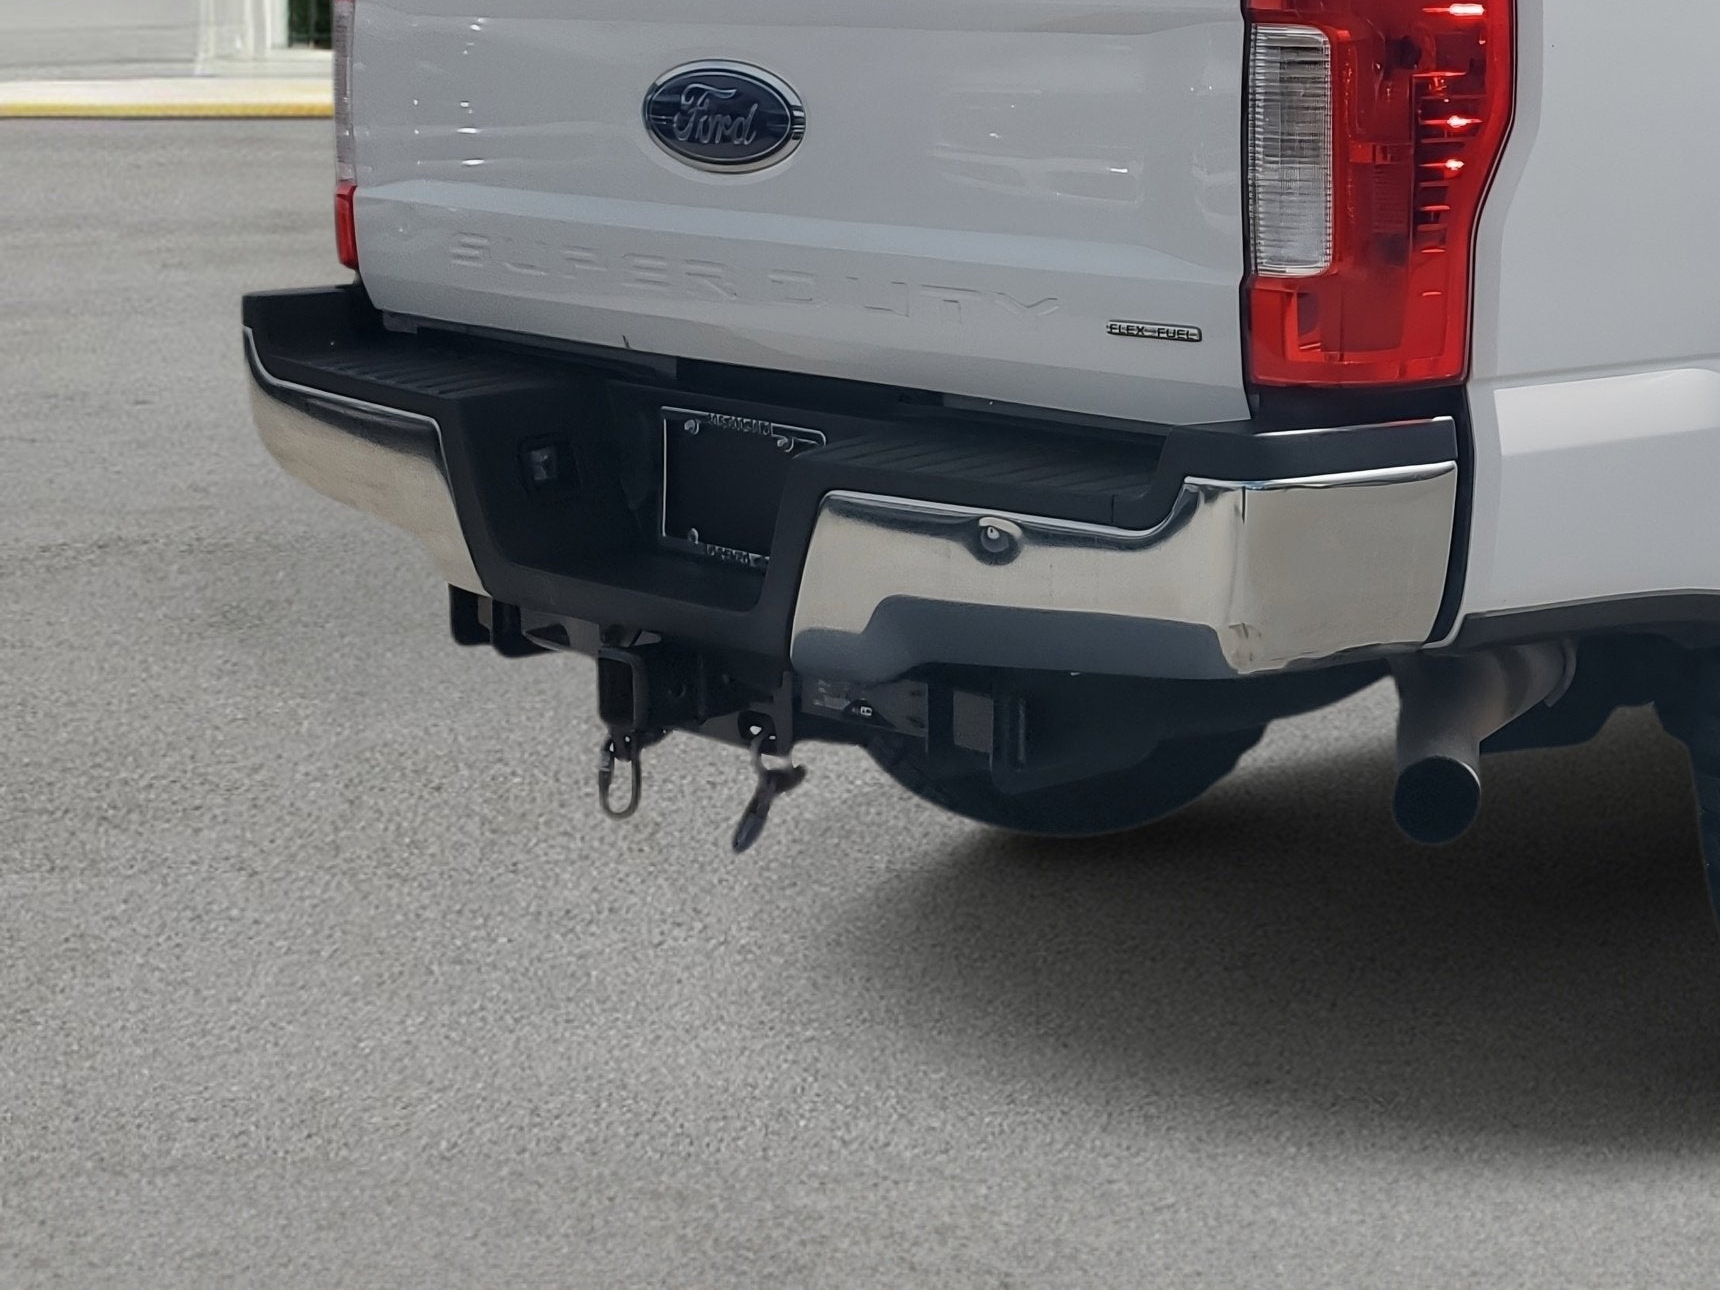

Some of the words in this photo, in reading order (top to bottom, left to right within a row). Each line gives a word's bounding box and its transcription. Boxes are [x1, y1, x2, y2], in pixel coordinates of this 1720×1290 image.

[673, 83, 759, 145] Ford
[449, 230, 738, 301] SUPER
[766, 267, 1060, 325] DUTY
